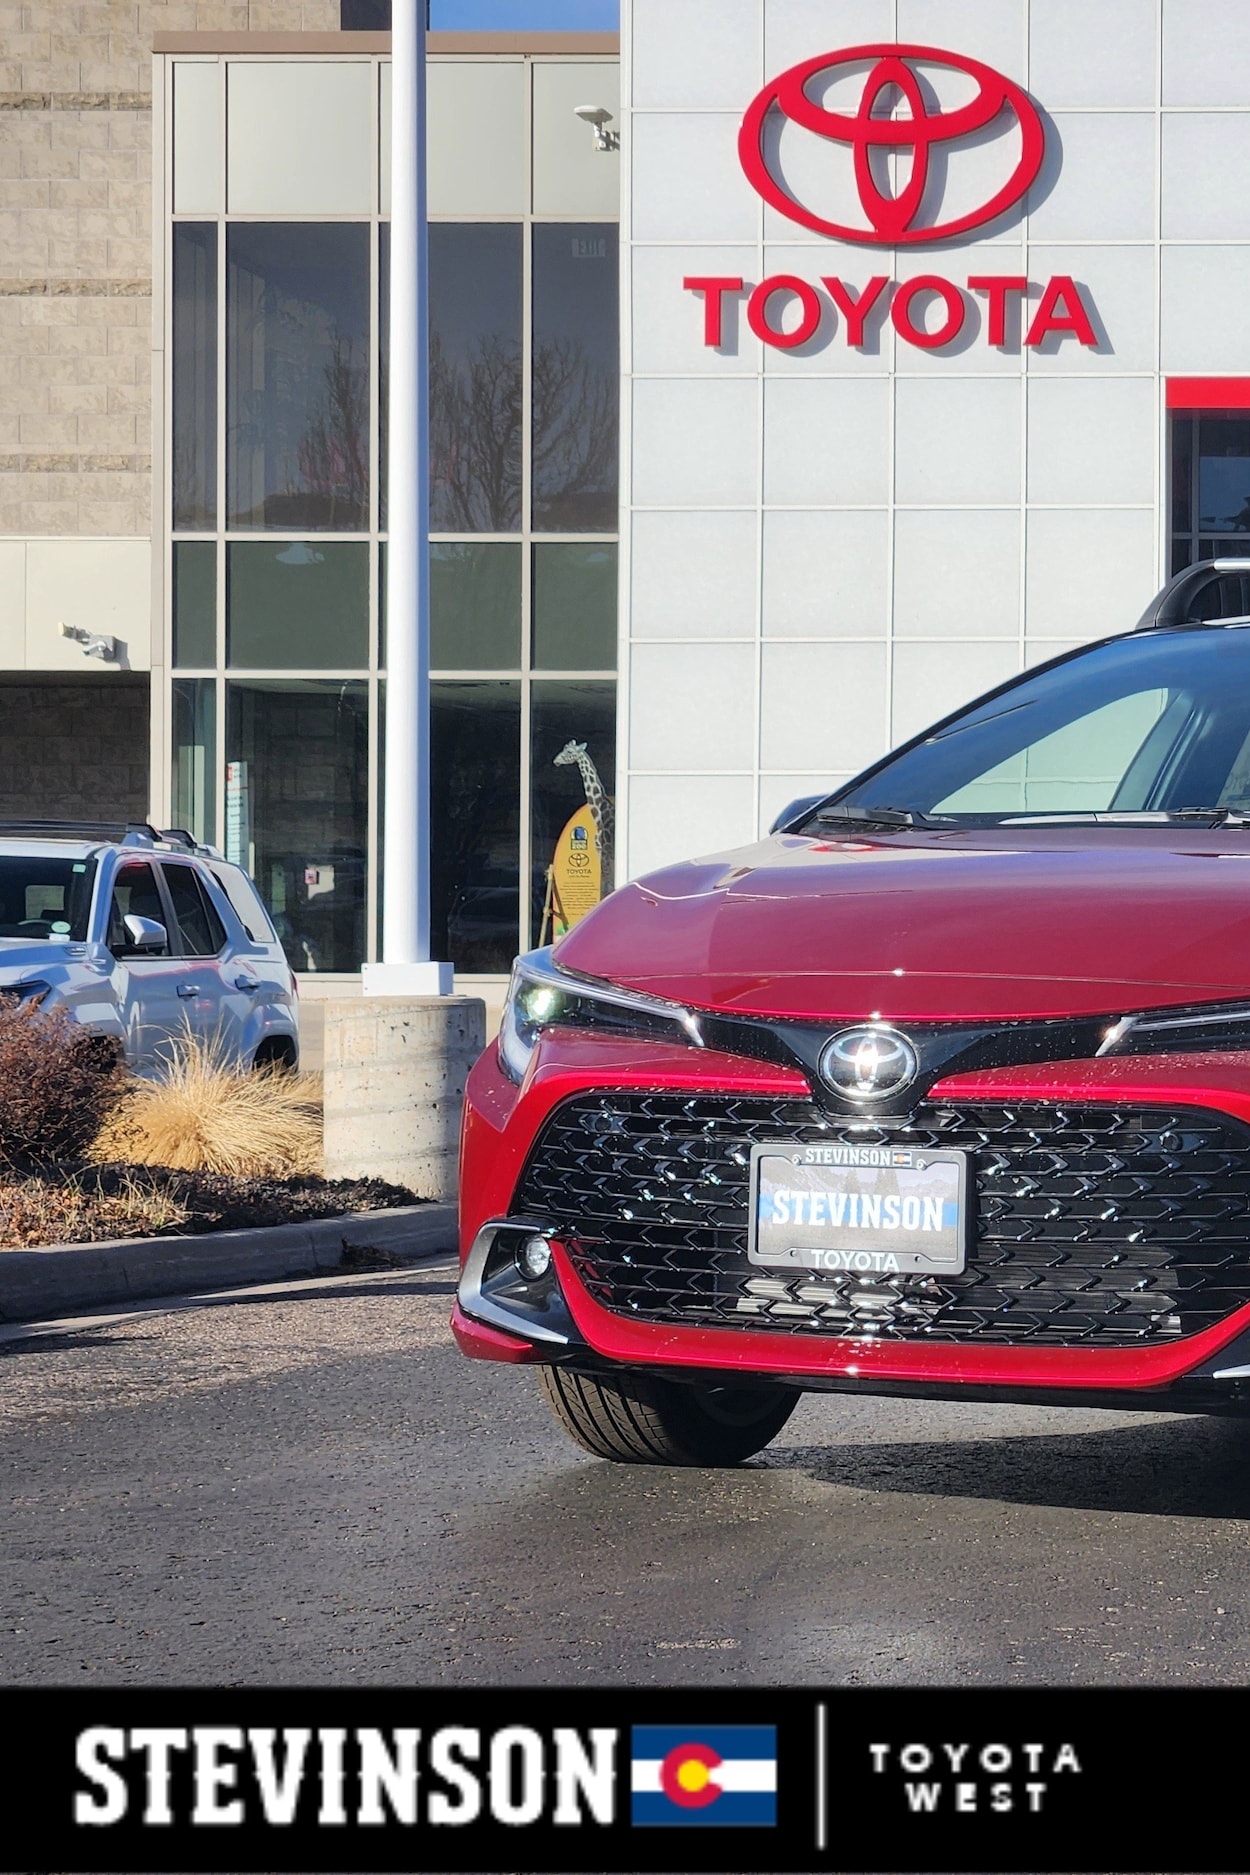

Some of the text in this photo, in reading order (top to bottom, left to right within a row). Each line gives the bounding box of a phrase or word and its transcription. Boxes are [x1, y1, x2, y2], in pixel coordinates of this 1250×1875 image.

[684, 275, 1097, 349] TOYOTA
[805, 1148, 891, 1166] STEVINSON
[772, 1189, 945, 1232] STEVINSON
[811, 1249, 900, 1272] TOYOTA
